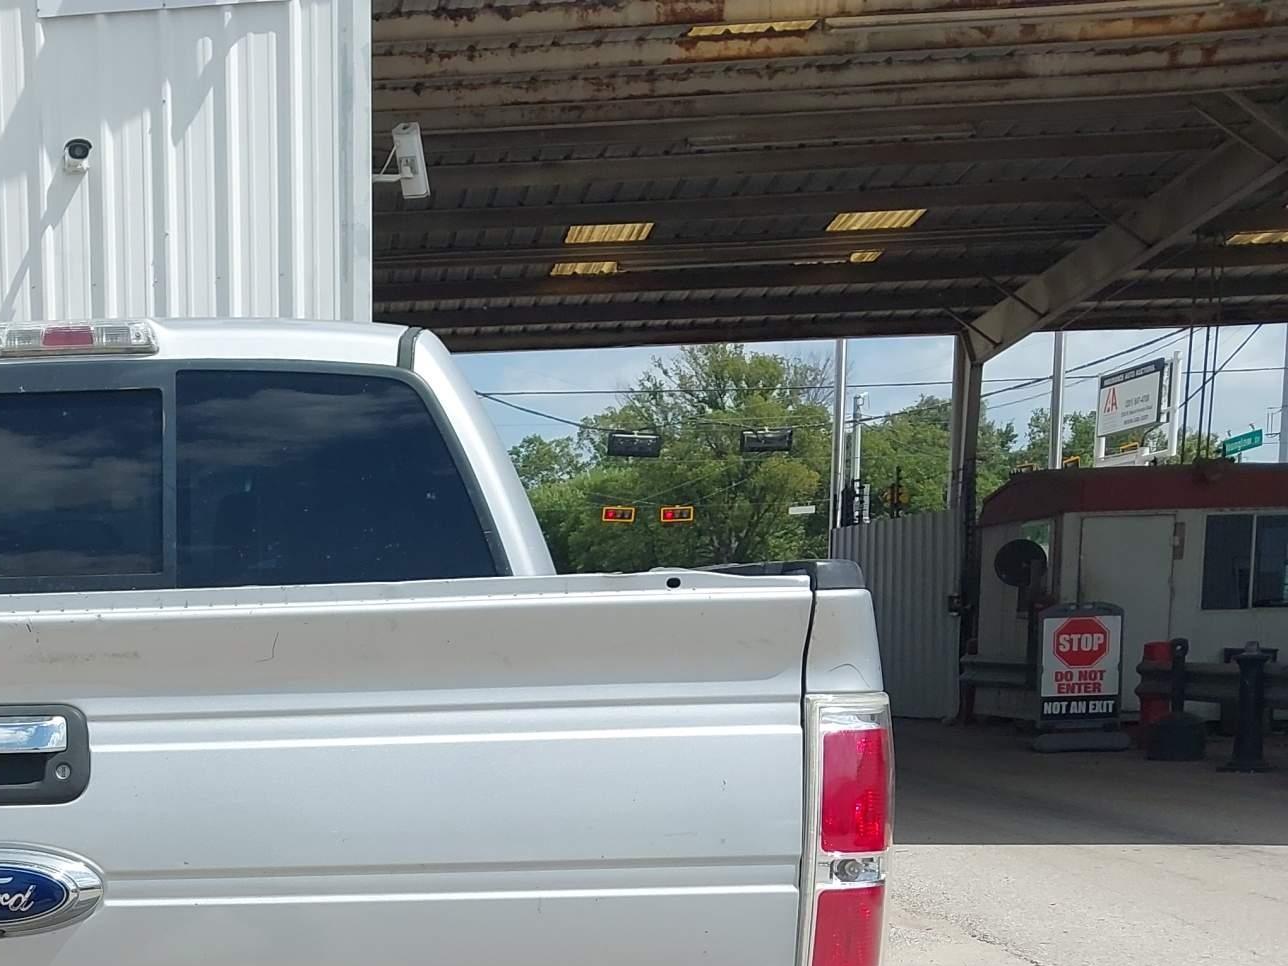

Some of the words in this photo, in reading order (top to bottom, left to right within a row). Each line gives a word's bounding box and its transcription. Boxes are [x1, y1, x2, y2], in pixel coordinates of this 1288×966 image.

[1058, 633, 1105, 653] STOP
[1054, 671, 1074, 682] DO
[1078, 670, 1106, 682] NOT
[1057, 682, 1102, 694] ENTER
[1043, 701, 1068, 714] NOT
[1070, 701, 1086, 714] AN
[1089, 700, 1115, 713] EXIT
